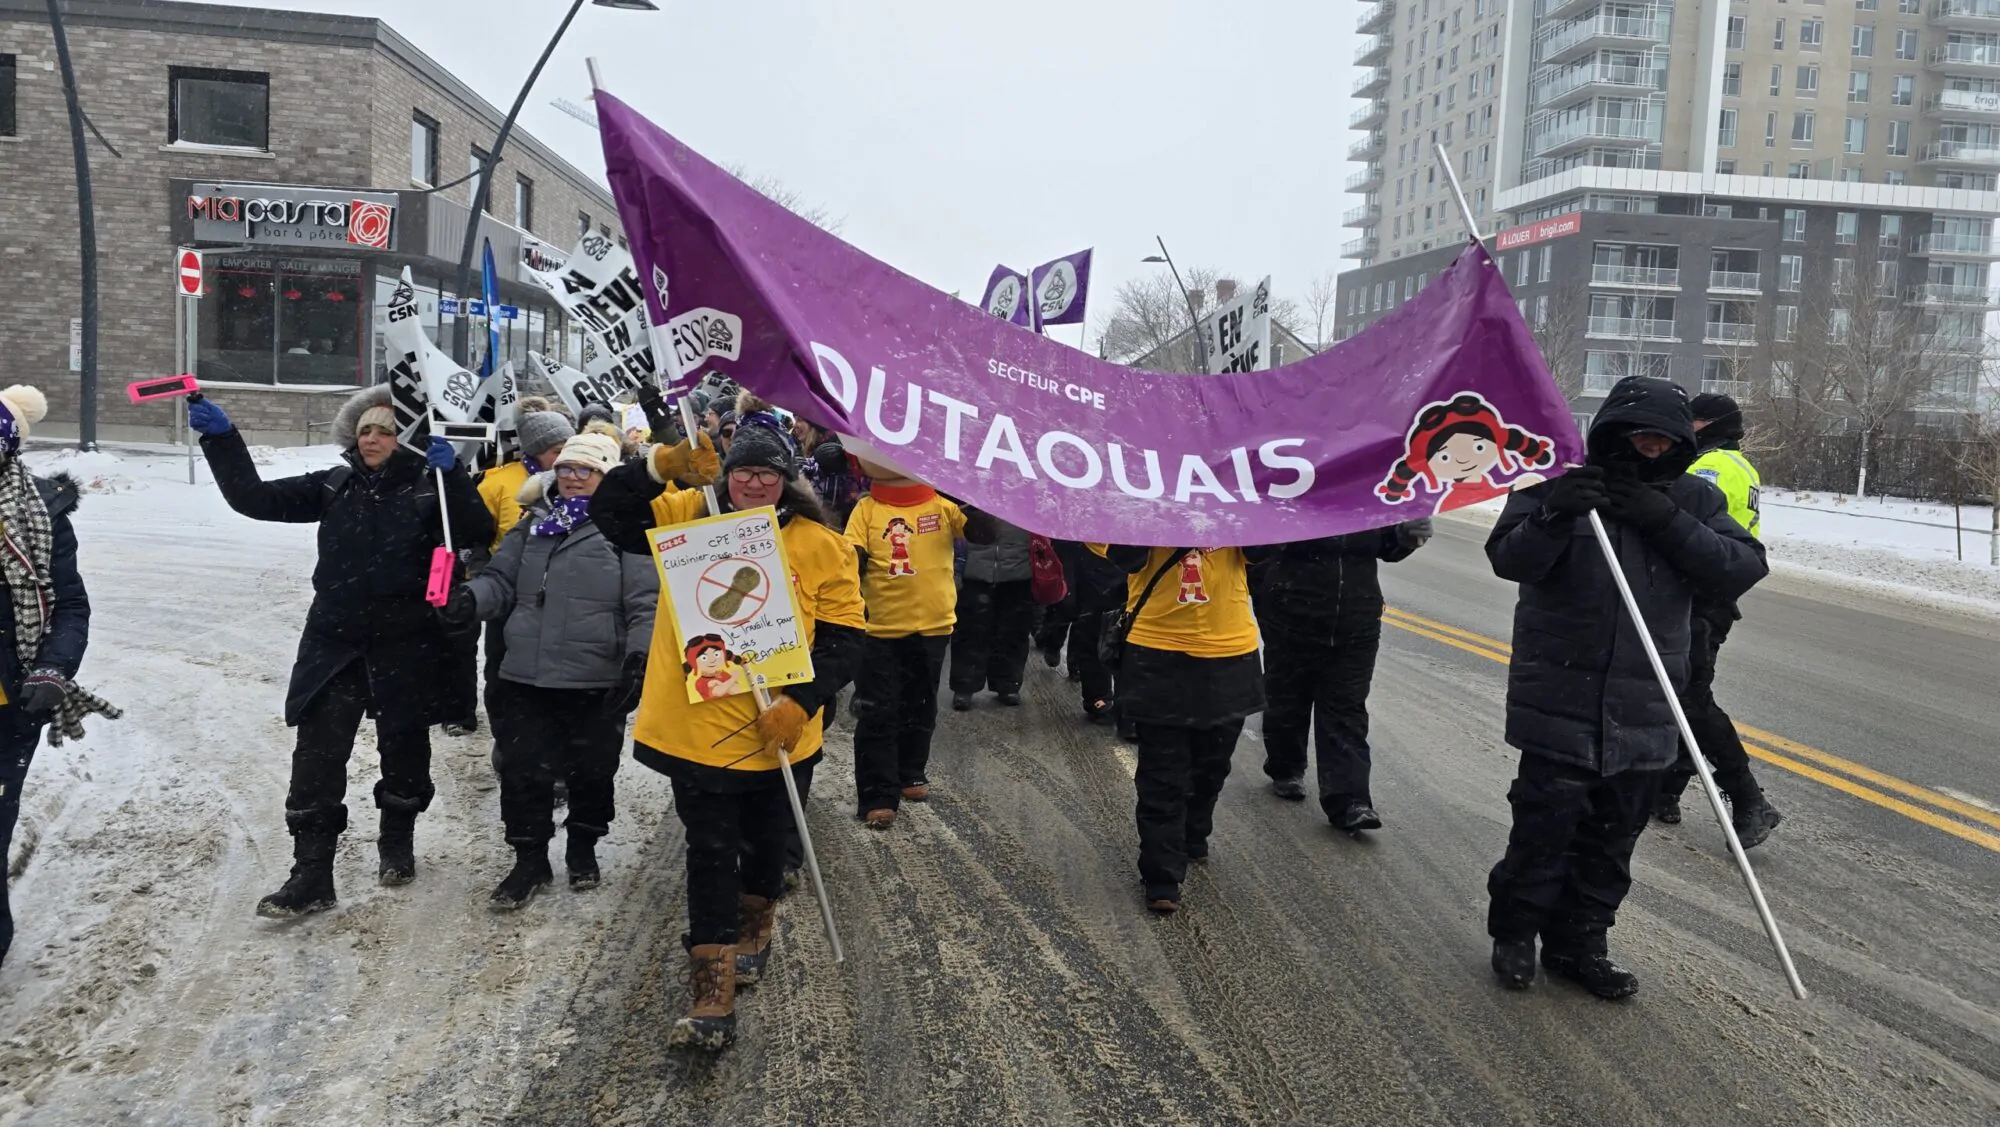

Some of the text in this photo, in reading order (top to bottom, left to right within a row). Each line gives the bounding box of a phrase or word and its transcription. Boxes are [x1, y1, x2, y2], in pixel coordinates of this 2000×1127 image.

[264, 227, 287, 238] bar
[1508, 230, 1530, 244] LOUER
[1540, 221, 1574, 238] brigil.com
[388, 303, 419, 323] CSN
[992, 307, 1008, 320] CSN
[1041, 299, 1065, 313] CSN
[602, 320, 632, 356] EN
[1219, 305, 1243, 356] EN
[708, 340, 733, 353] CSN
[988, 358, 1106, 411] SECTEUR CPE
[442, 389, 470, 414] CSN
[501, 393, 516, 406] SN
[811, 341, 1315, 504] OUTAOUAIS
[742, 541, 773, 555] 28.95
[721, 628, 740, 646] Je
[776, 616, 795, 627] pour
[741, 639, 756, 650] des
